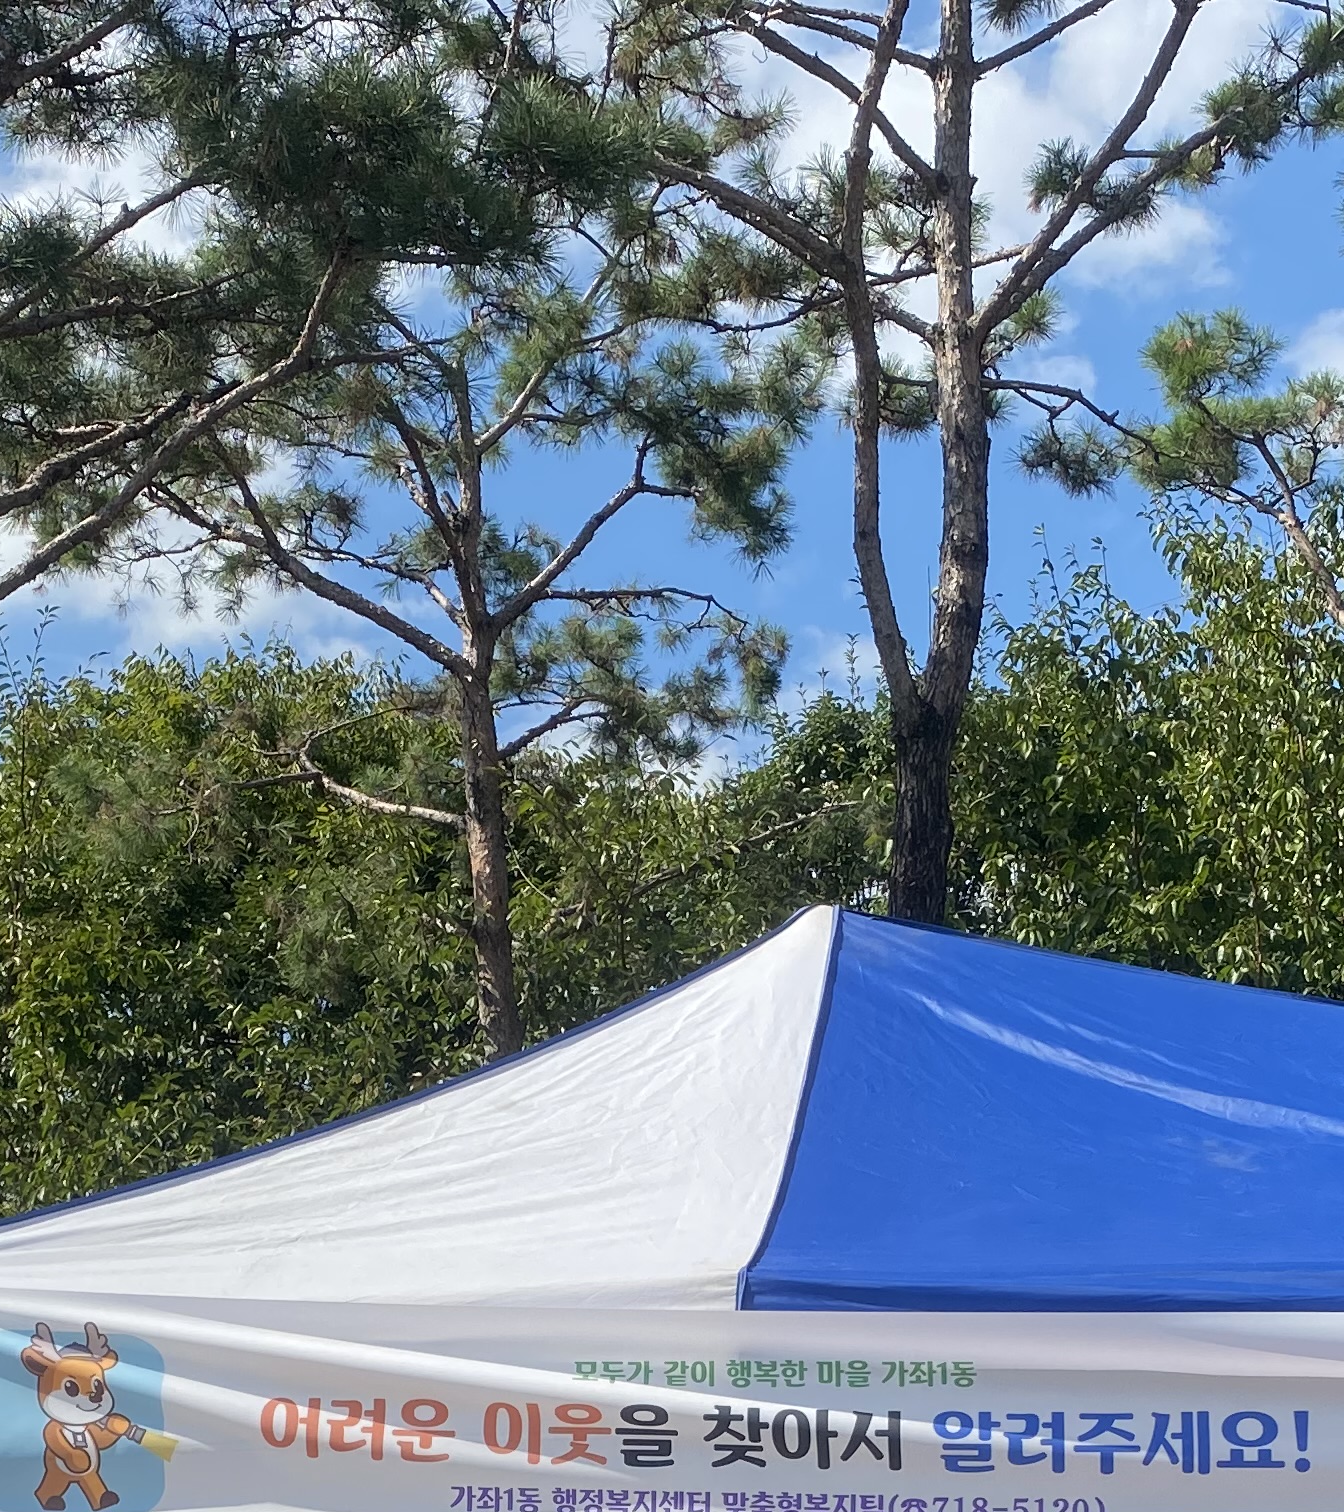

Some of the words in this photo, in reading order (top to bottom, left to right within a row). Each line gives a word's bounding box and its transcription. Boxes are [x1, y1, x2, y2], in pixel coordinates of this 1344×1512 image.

[573, 1360, 654, 1386] 모두가
[664, 1360, 715, 1387] 같이
[726, 1361, 807, 1388] 행복한
[818, 1361, 872, 1388] 마을
[881, 1362, 977, 1388] 가좌1동
[260, 1397, 456, 1463] 어려운
[482, 1401, 679, 1468] 이웃을
[702, 1405, 903, 1471] 찾아서
[932, 1410, 1311, 1475] 알려주세요!
